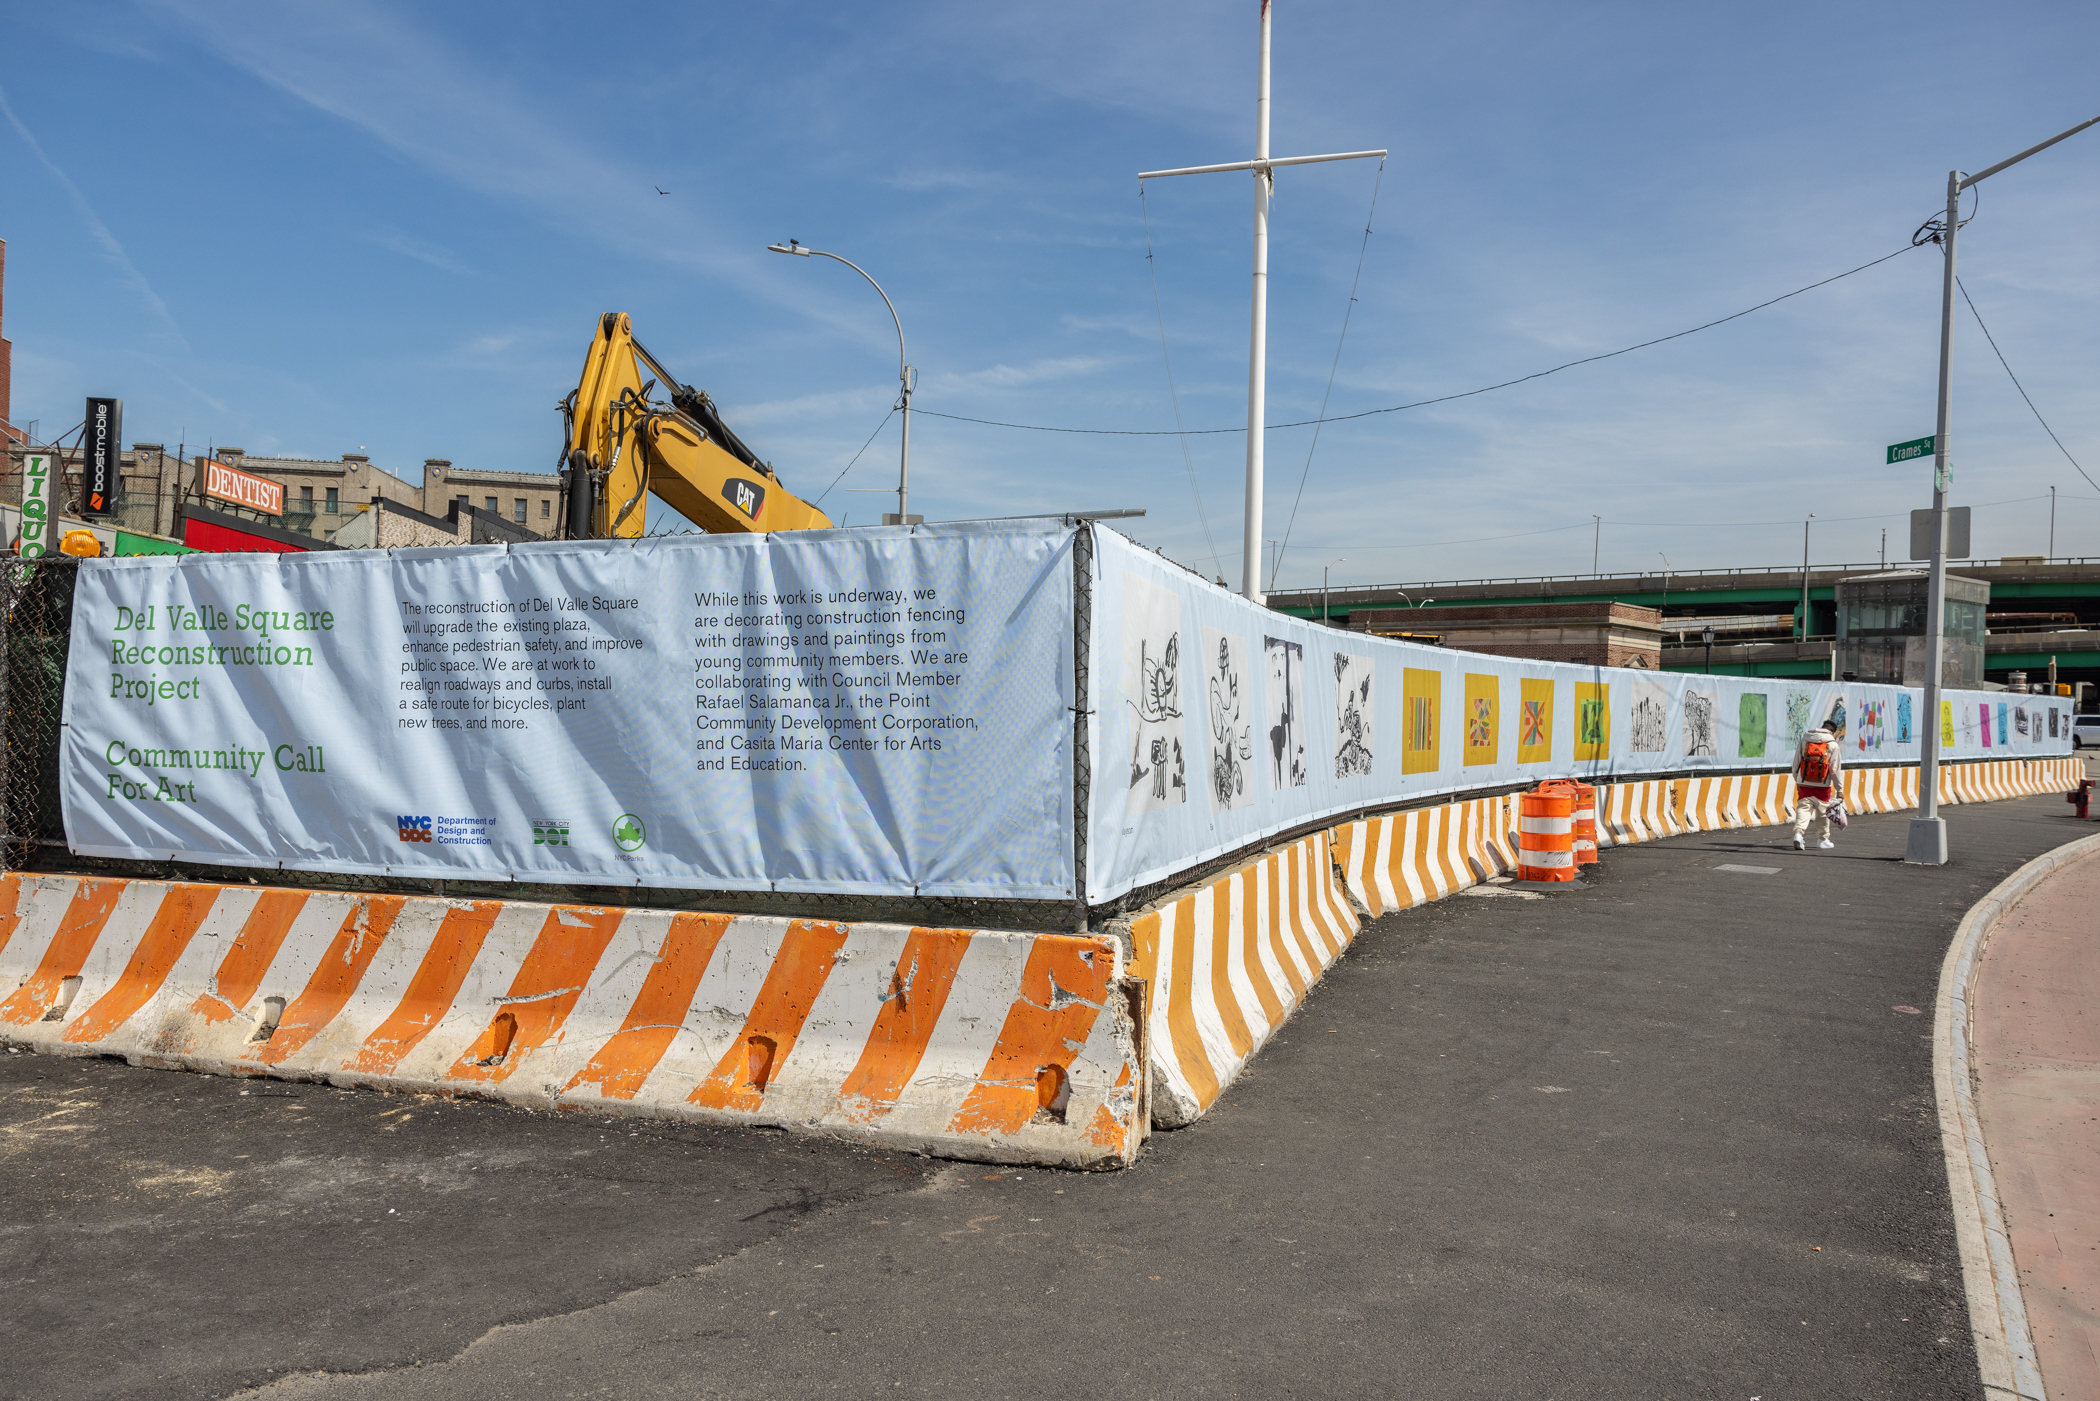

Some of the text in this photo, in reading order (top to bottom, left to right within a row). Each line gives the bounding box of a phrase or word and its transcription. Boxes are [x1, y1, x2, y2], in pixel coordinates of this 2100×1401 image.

[1892, 440, 1930, 461] Crames Sq
[208, 465, 280, 510] DENTIST
[736, 482, 755, 516] CAT
[402, 595, 638, 614] The reconstruction of Del Valle Square
[695, 588, 936, 606] While this work is underway, we
[114, 604, 334, 637] Del Valle Square
[403, 617, 590, 636] will upgrade the existing plaza,
[695, 606, 964, 629] are decorating construction fencing
[402, 636, 643, 655] enhance pedestrian safety, and improve
[695, 629, 945, 650] with drawings and paintings from
[112, 639, 313, 665] Reconstruction
[695, 650, 967, 672] young community members. We are
[402, 657, 595, 675] public space. We are at work to
[110, 673, 199, 706] Project
[401, 676, 611, 694] realign roadways and curbs, install
[696, 671, 961, 691] collaborating with Council Member
[399, 696, 585, 713] a safe route for bicycles, plant
[697, 693, 930, 710] Rafael Salamanca Jr., the Point
[399, 716, 528, 730] new trees, and more.
[697, 714, 978, 733] Community Development Corporation,
[697, 735, 941, 750] and Casita Maria Center for Arts
[106, 740, 325, 777] Community Call
[697, 756, 806, 771] and Education.
[107, 774, 196, 802] For Art
[397, 815, 432, 829] NYC
[438, 816, 487, 827] Department
[438, 826, 485, 836] Design and
[399, 828, 432, 843] DDC
[438, 836, 492, 845] Construction
[534, 828, 569, 846] DOT
